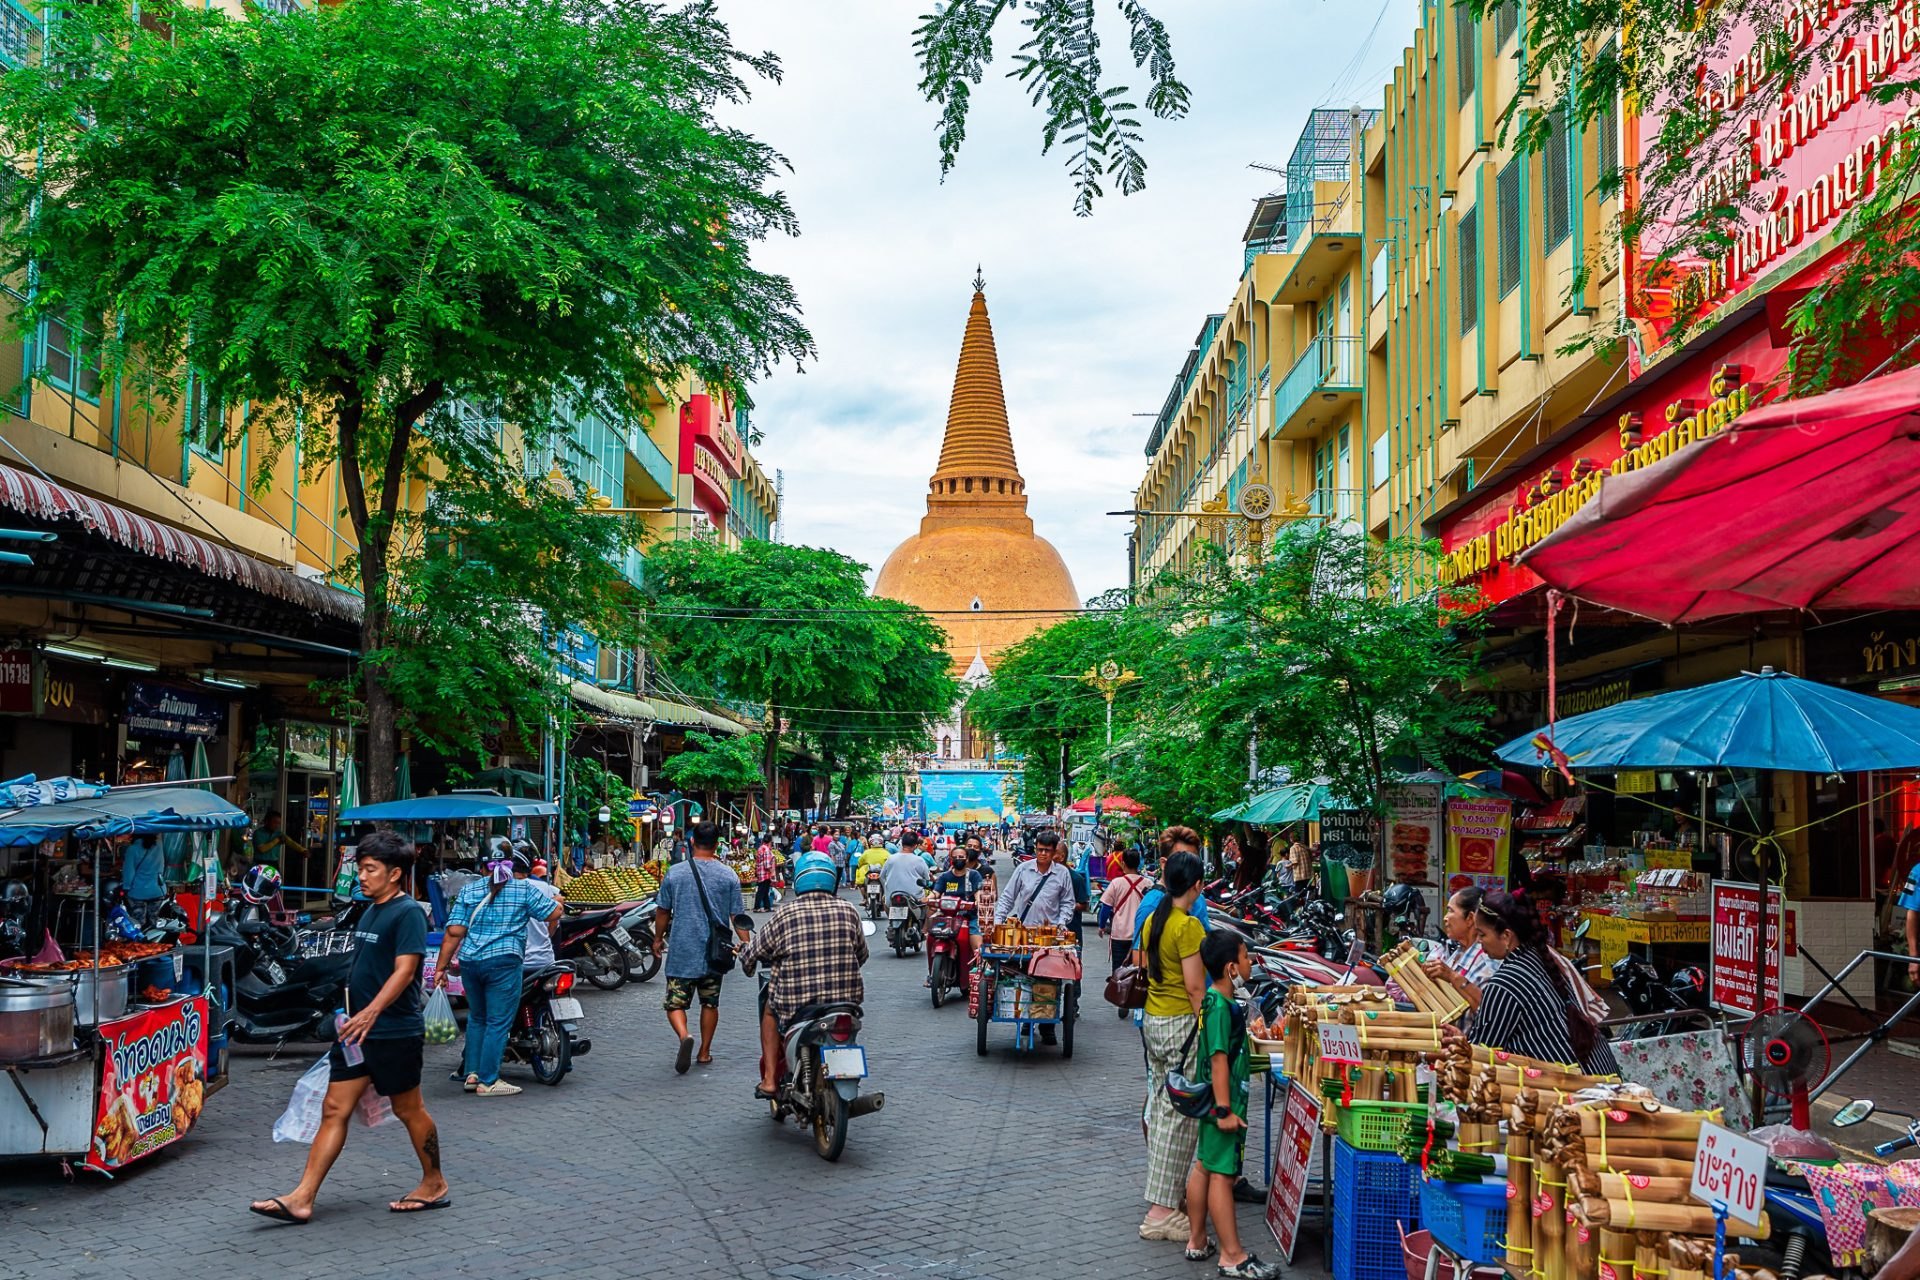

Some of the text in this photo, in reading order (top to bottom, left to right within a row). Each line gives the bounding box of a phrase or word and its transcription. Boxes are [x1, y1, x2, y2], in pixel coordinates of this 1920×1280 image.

[1863, 630, 1920, 672] ห้าง
[1347, 827, 1371, 844] ไข่มุ
[1715, 911, 1754, 962] แม่เล็ก
[1322, 1029, 1359, 1058] บ๊ะจ่าง
[1698, 1135, 1758, 1211] บ๊ะจ่าง
